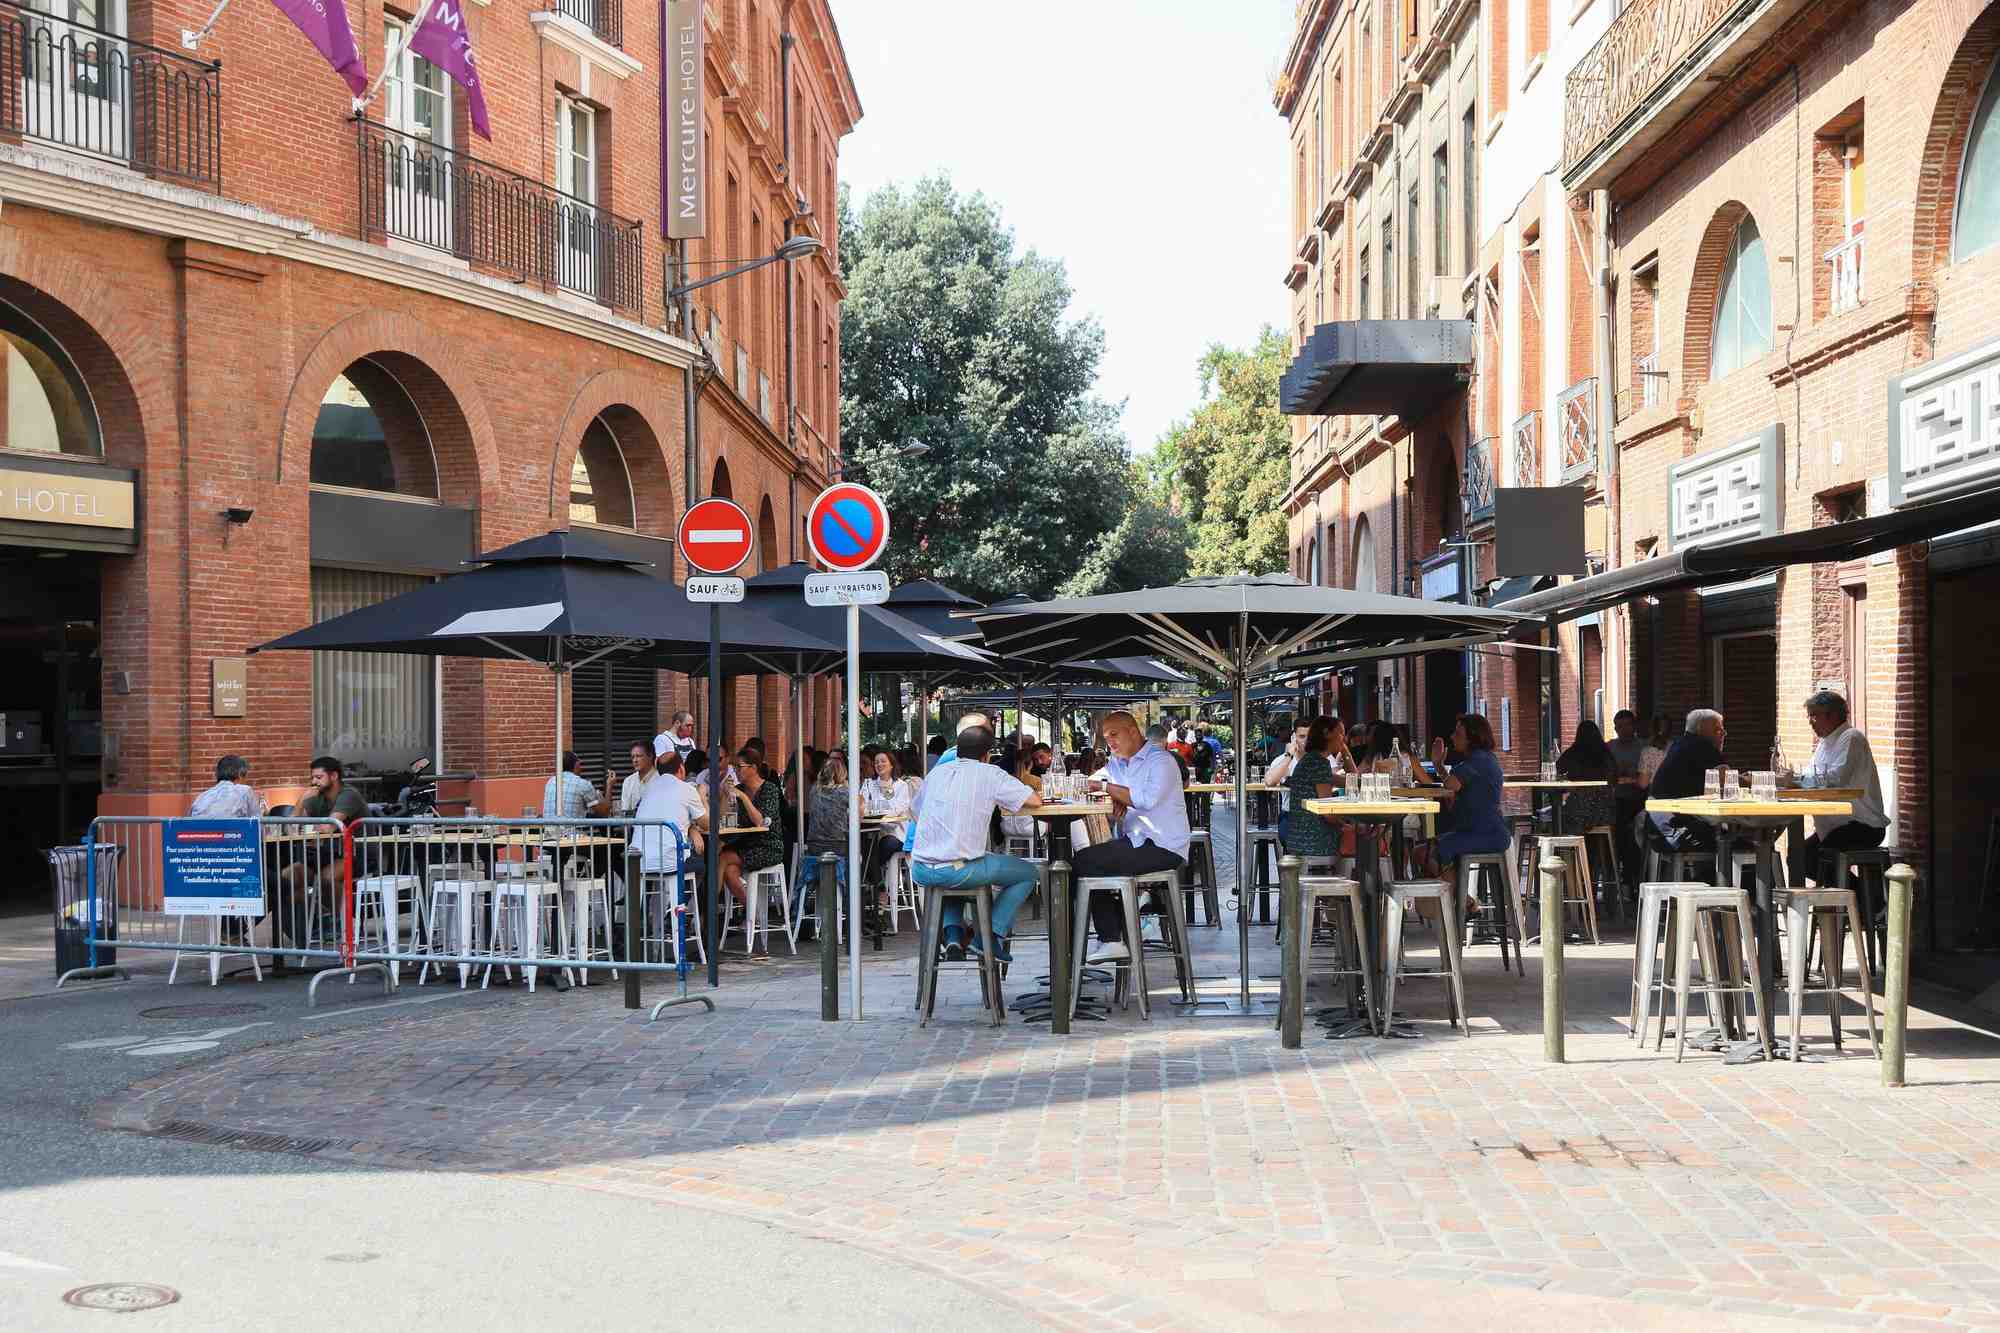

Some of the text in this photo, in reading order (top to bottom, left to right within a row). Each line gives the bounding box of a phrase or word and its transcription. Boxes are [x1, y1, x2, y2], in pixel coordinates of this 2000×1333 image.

[679, 16, 697, 219] Mercure HOTEL
[15, 487, 105, 517] HOTEL
[688, 583, 719, 595] SAUF
[808, 585, 831, 595] SAUF
